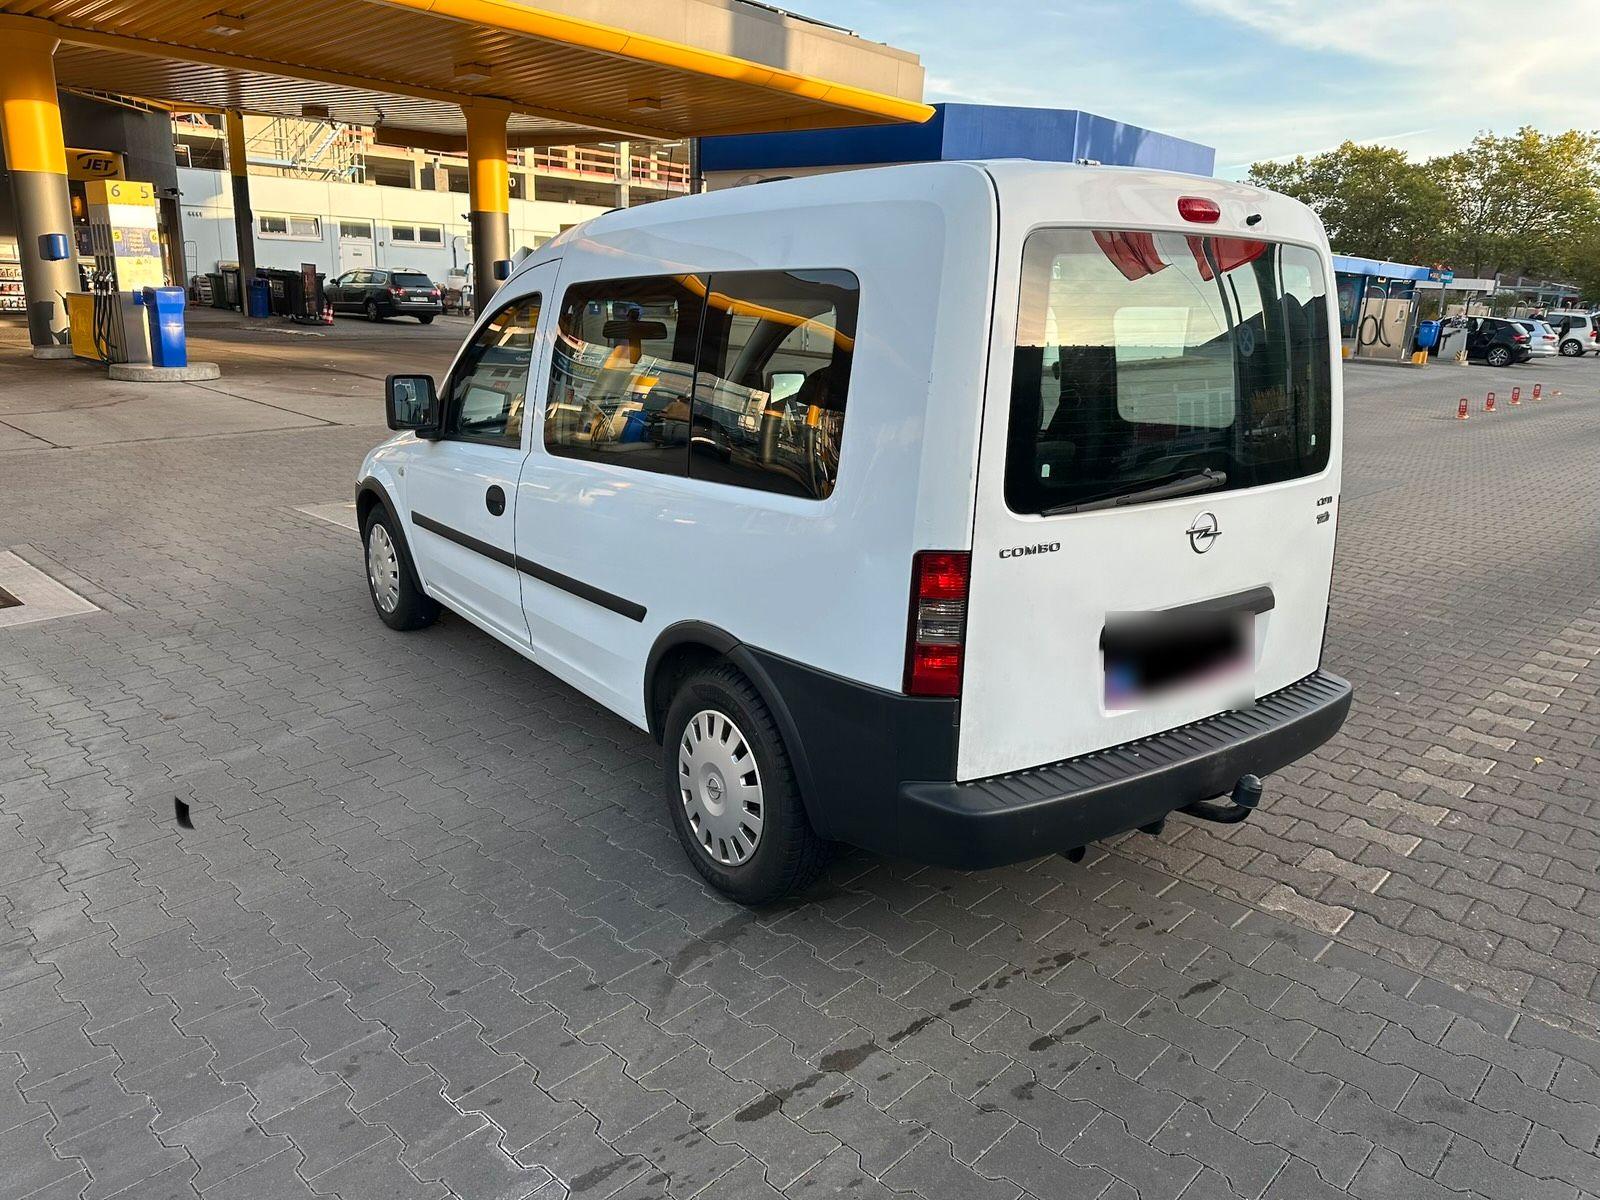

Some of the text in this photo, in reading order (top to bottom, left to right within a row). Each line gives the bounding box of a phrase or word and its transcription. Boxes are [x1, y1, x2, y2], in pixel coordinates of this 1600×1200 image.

[82, 158, 113, 171] JET
[111, 184, 149, 199] 6 5
[999, 542, 1061, 559] COMBO
